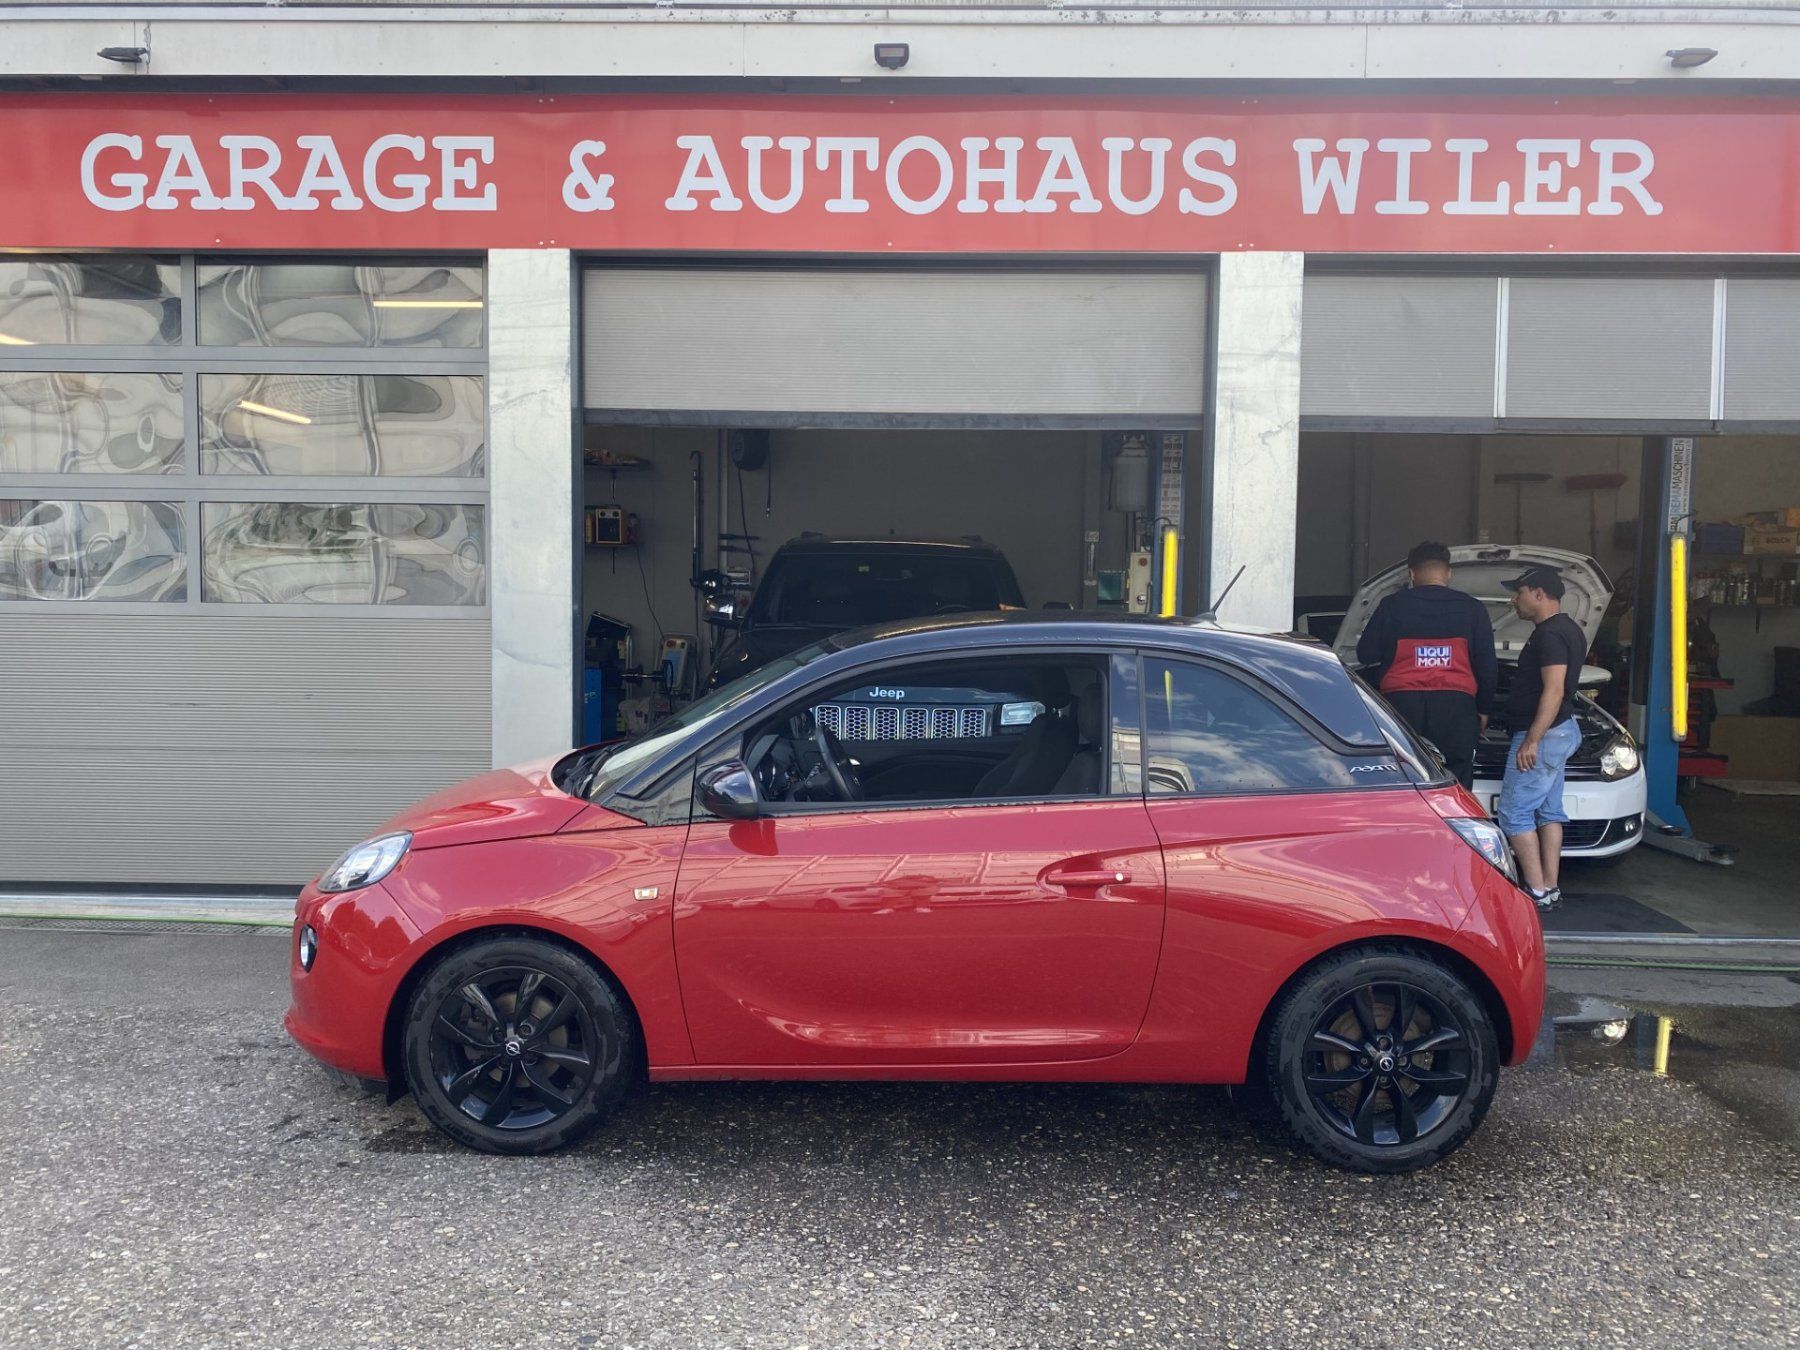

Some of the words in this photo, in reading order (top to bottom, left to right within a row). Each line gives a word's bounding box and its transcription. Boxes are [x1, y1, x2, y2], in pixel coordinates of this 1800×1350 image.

[80, 132, 498, 214] GARAGE
[561, 139, 615, 214] &
[664, 135, 1238, 217] AUTOHAUS
[1292, 137, 1664, 217] WILER
[1670, 440, 1685, 513] REMAMASCHINEN
[1418, 647, 1449, 657] LIQUI
[1418, 657, 1450, 667] MOLY
[869, 687, 905, 700] Jeep
